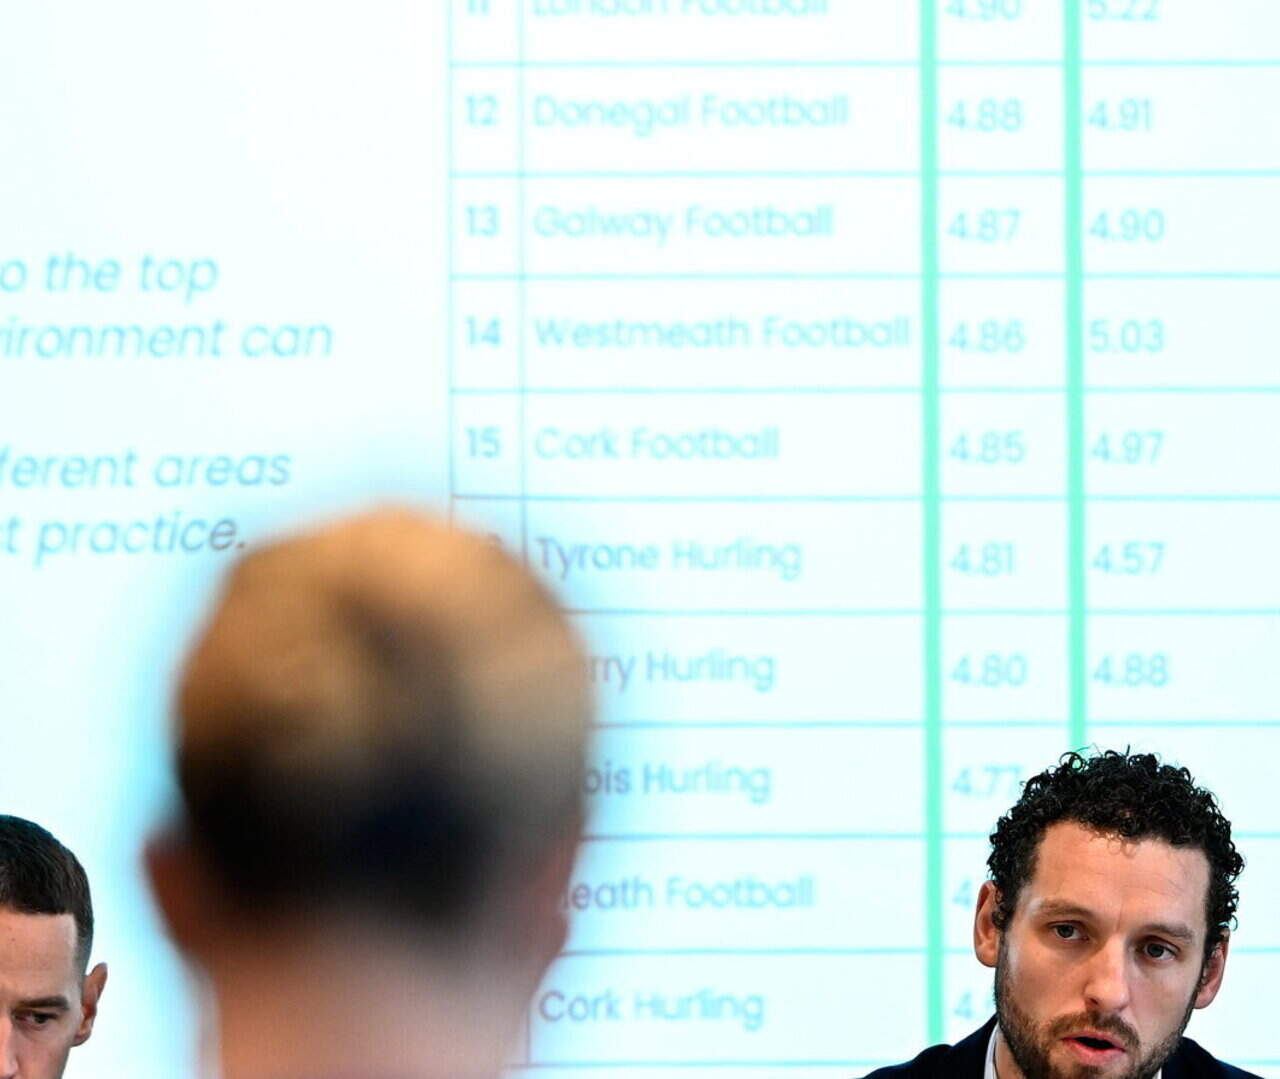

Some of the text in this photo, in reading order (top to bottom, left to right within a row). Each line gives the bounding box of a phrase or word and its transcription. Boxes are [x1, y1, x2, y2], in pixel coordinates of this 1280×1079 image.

[464, 93, 849, 138] 12 Donegal Football
[464, 204, 833, 246] 13 Galway Football
[46, 252, 122, 292] the
[140, 254, 219, 304] top
[241, 324, 333, 357] can
[466, 316, 501, 347] 14
[534, 318, 750, 348] Westmeath
[763, 316, 912, 348] Football
[1086, 318, 1165, 353] 5.03
[465, 427, 780, 460] 15 Cork Football
[154, 454, 292, 488] areas
[35, 512, 248, 566] practice.
[537, 536, 658, 580] Tyrone
[672, 539, 803, 582] Hurling
[1088, 541, 1166, 576] 4.57
[641, 650, 776, 693] Hurling
[638, 761, 771, 809] Hurling
[666, 876, 814, 909] Football
[538, 988, 765, 1032] Cork Hurling
